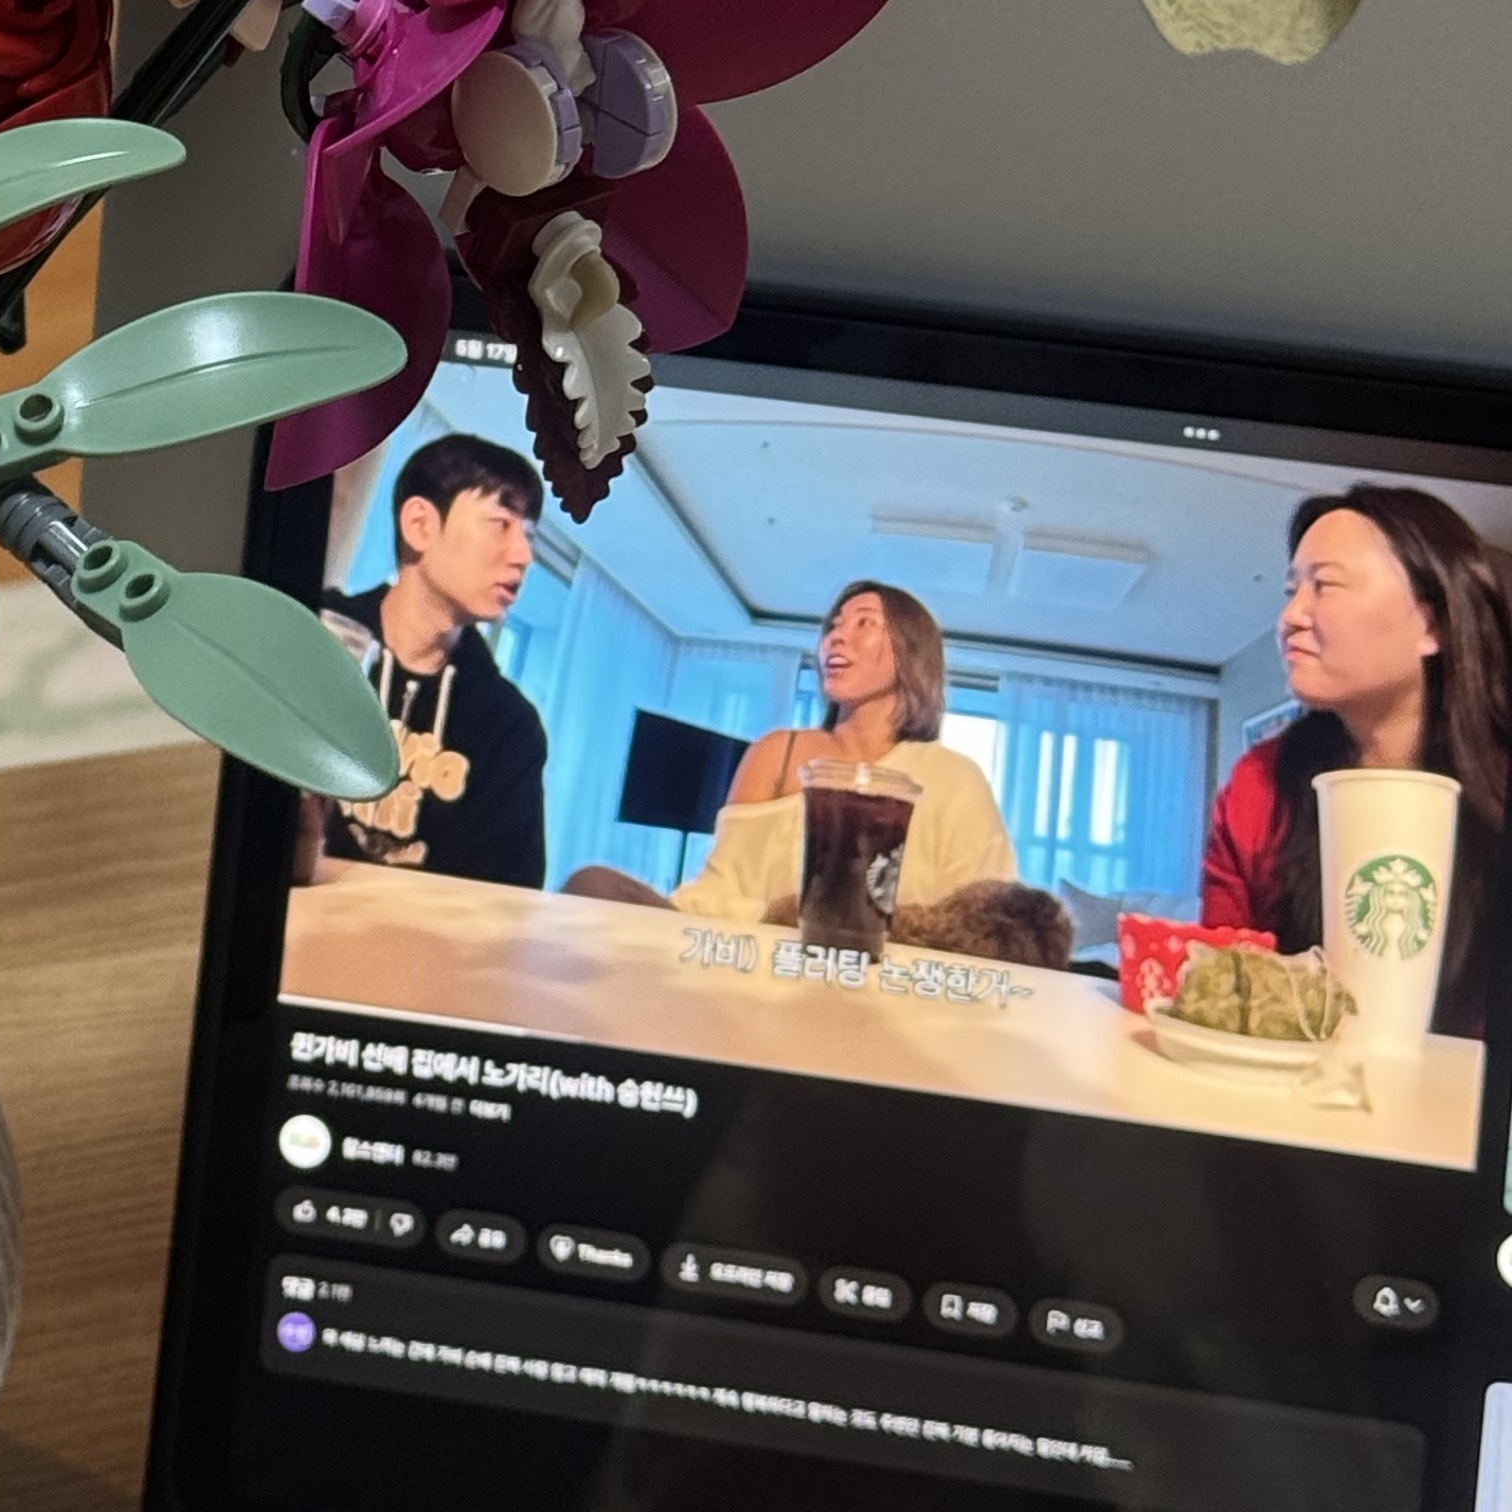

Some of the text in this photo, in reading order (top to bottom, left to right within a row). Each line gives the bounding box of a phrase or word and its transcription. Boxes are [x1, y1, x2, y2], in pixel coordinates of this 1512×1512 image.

[679, 928, 756, 972] 가비)
[772, 939, 870, 988] 플러팅
[411, 1048, 481, 1086] 집에서
